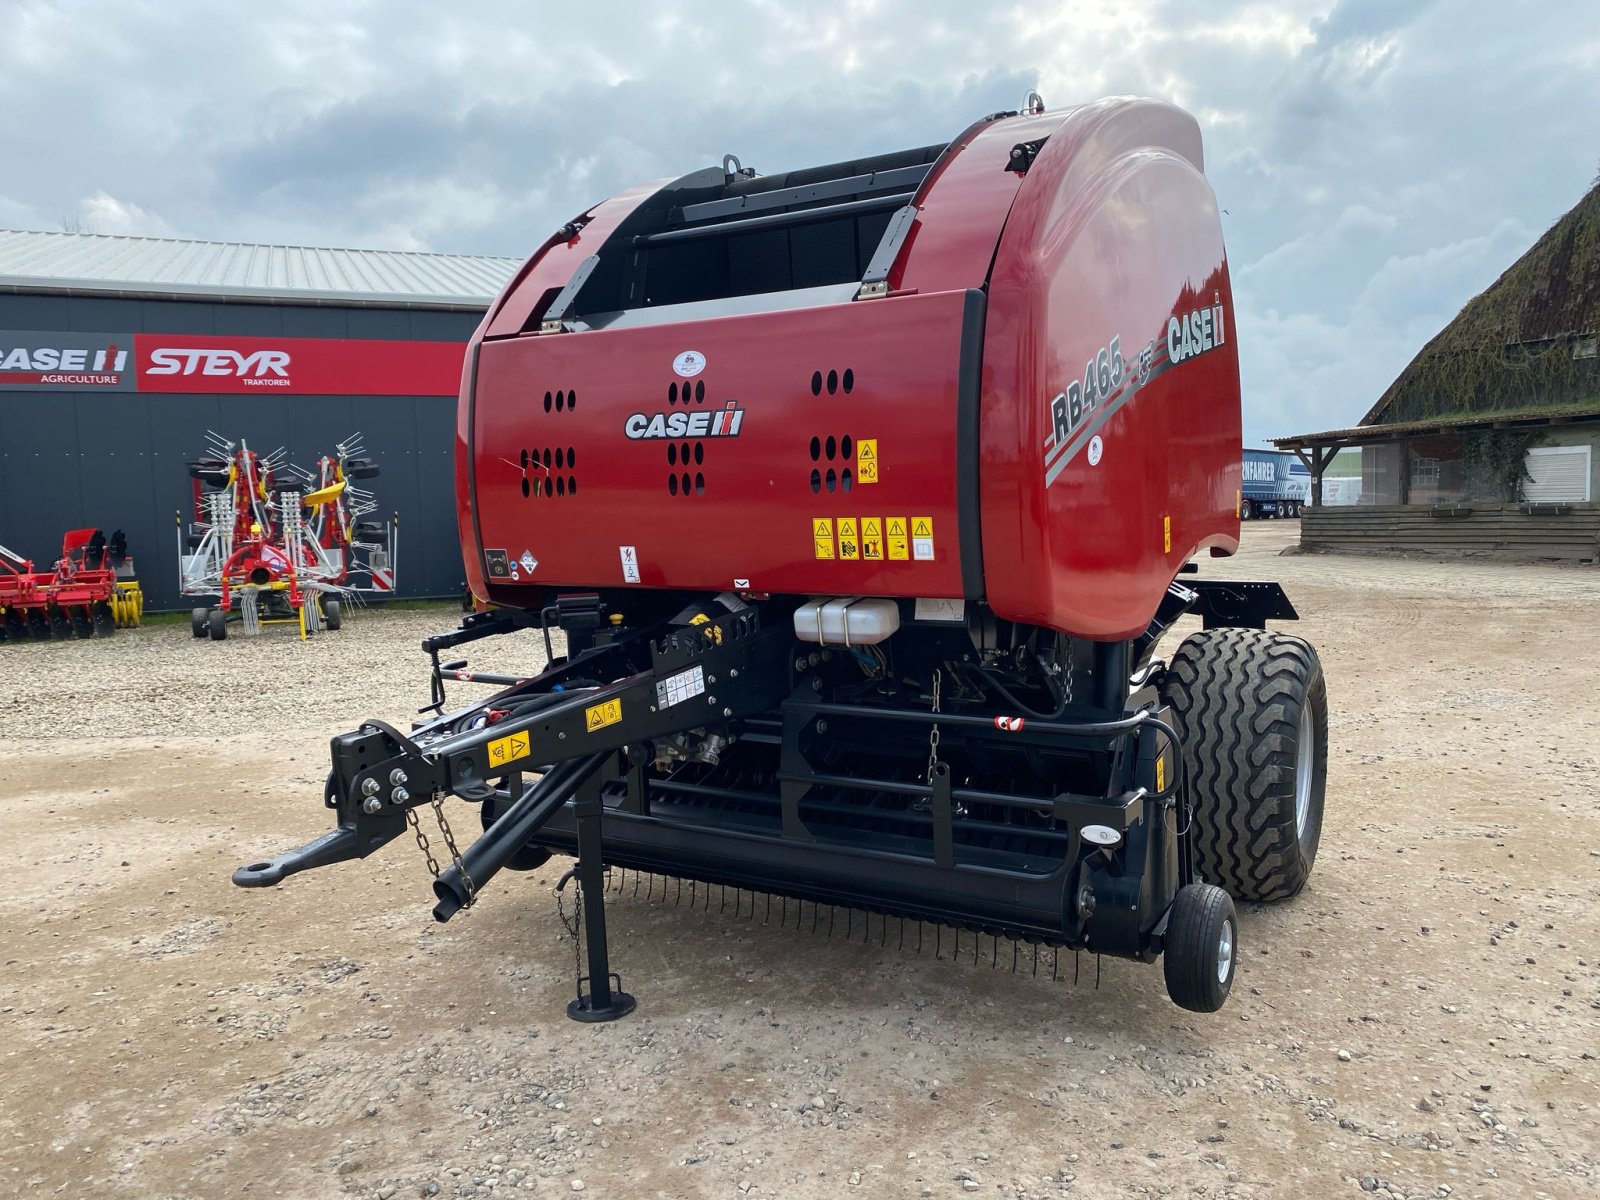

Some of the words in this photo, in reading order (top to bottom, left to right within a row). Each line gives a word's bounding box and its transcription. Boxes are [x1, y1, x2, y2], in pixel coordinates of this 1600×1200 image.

[1167, 308, 1212, 364] CASE
[0, 348, 88, 370] ASE
[145, 348, 291, 376] STEYR
[40, 374, 118, 384] AGRICULTURE
[243, 378, 290, 386] TRAKTOREN
[624, 412, 711, 439] CASE
